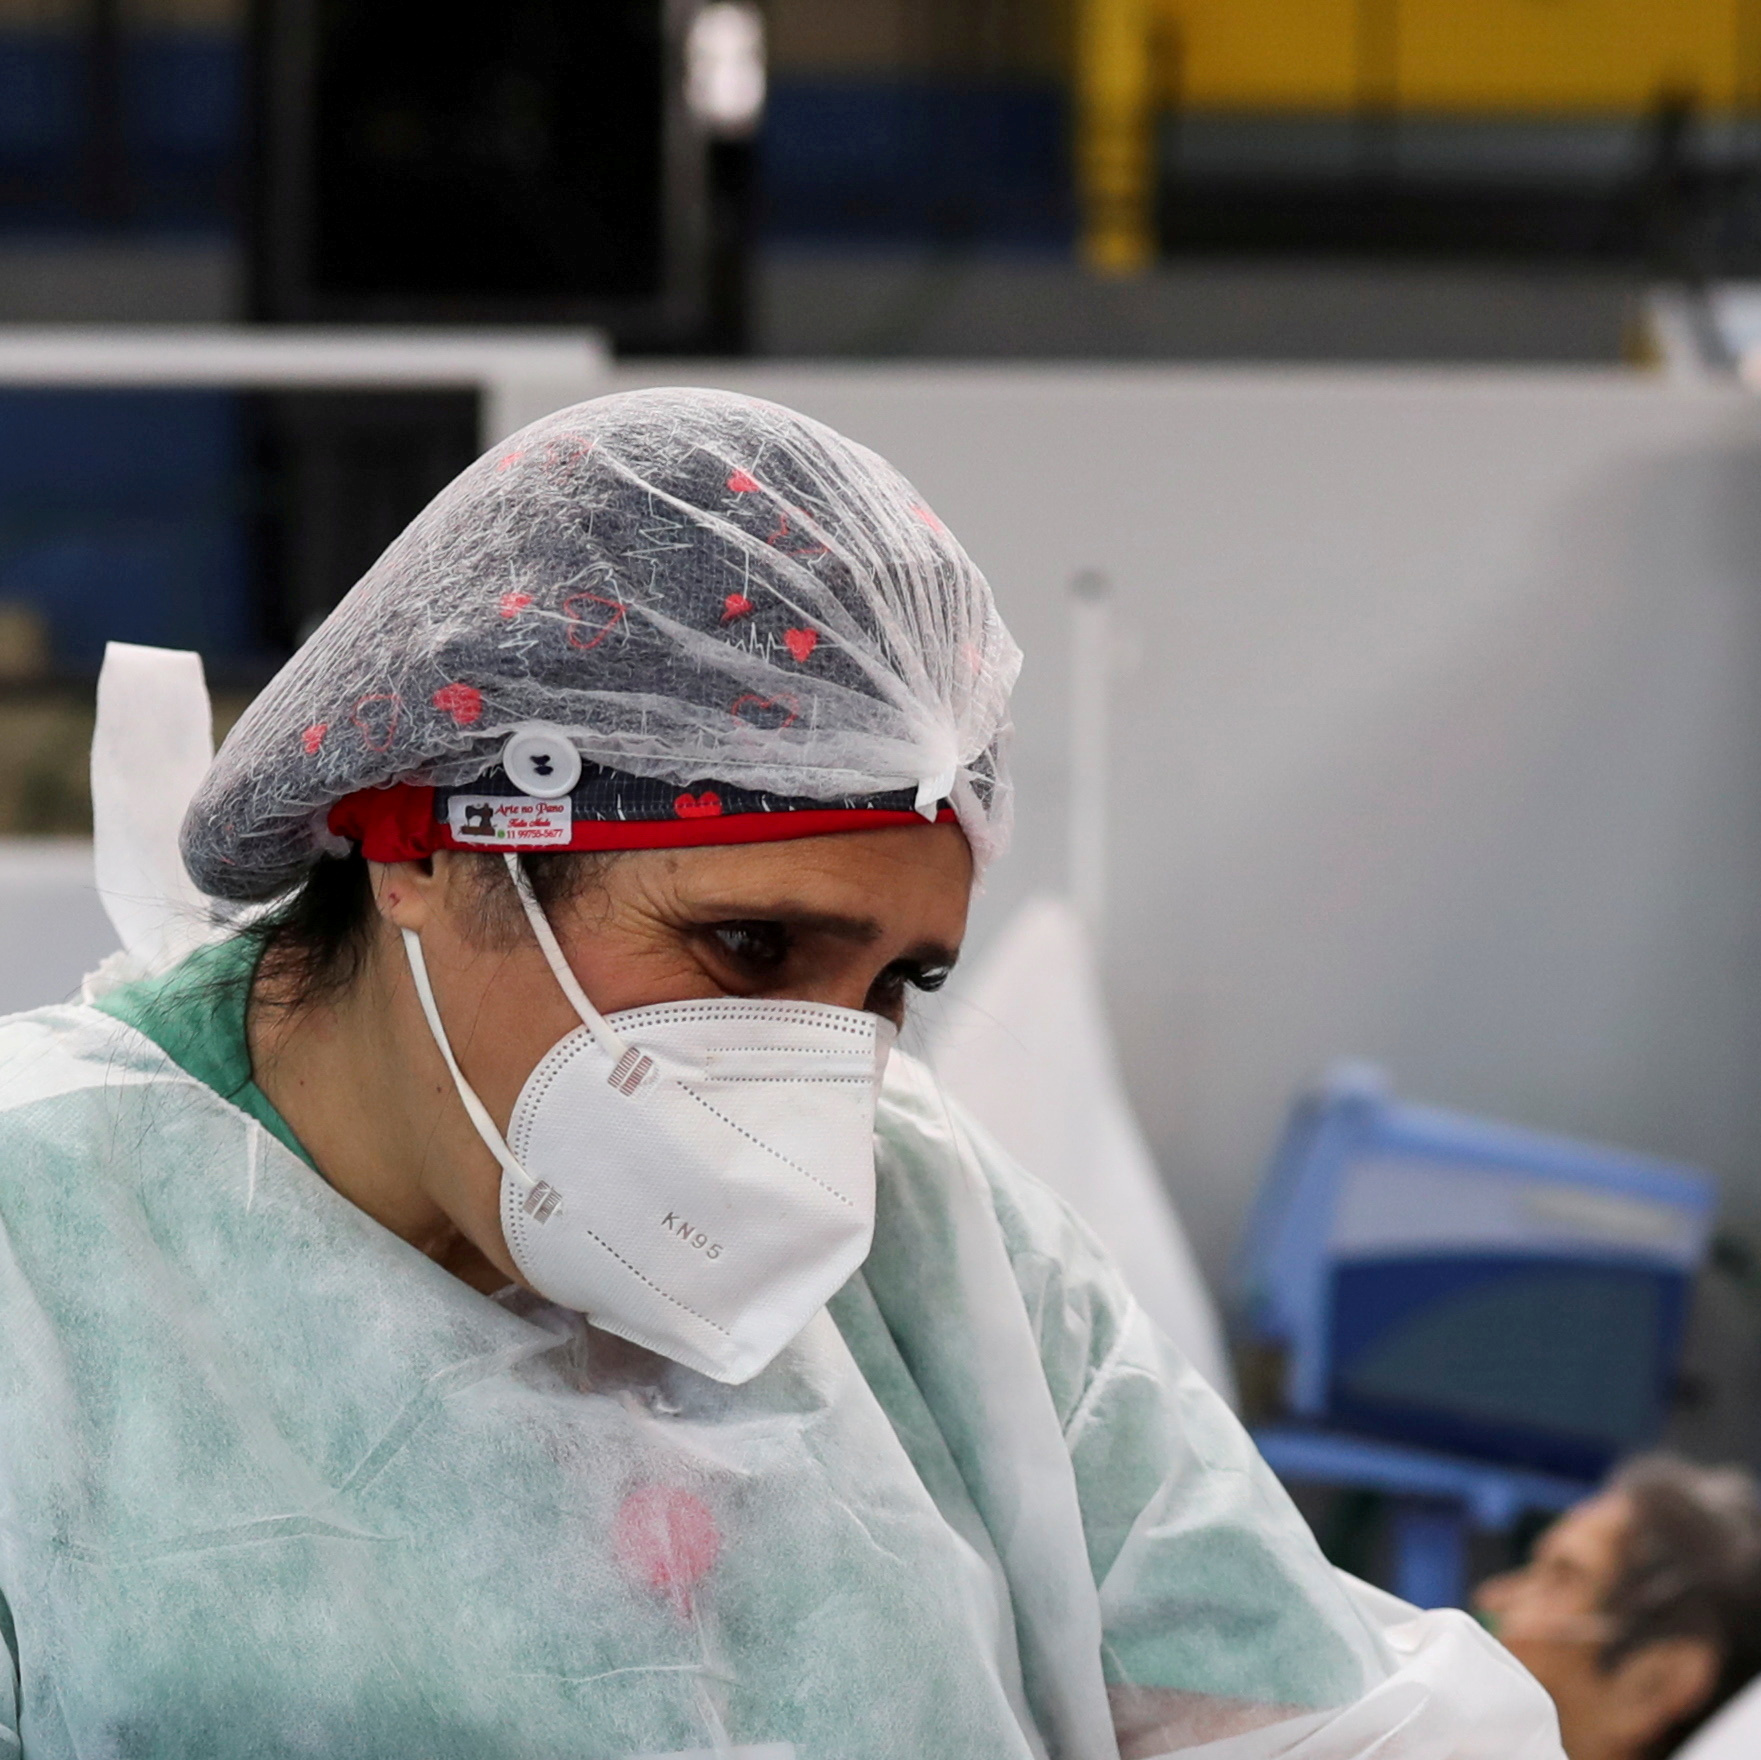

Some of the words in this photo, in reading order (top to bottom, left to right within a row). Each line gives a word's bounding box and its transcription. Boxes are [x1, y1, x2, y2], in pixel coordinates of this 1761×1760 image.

[495, 804, 519, 816] Arte
[521, 805, 533, 814] no
[536, 802, 564, 816] Pano
[507, 830, 515, 838] 11
[660, 1211, 724, 1260] KN95
